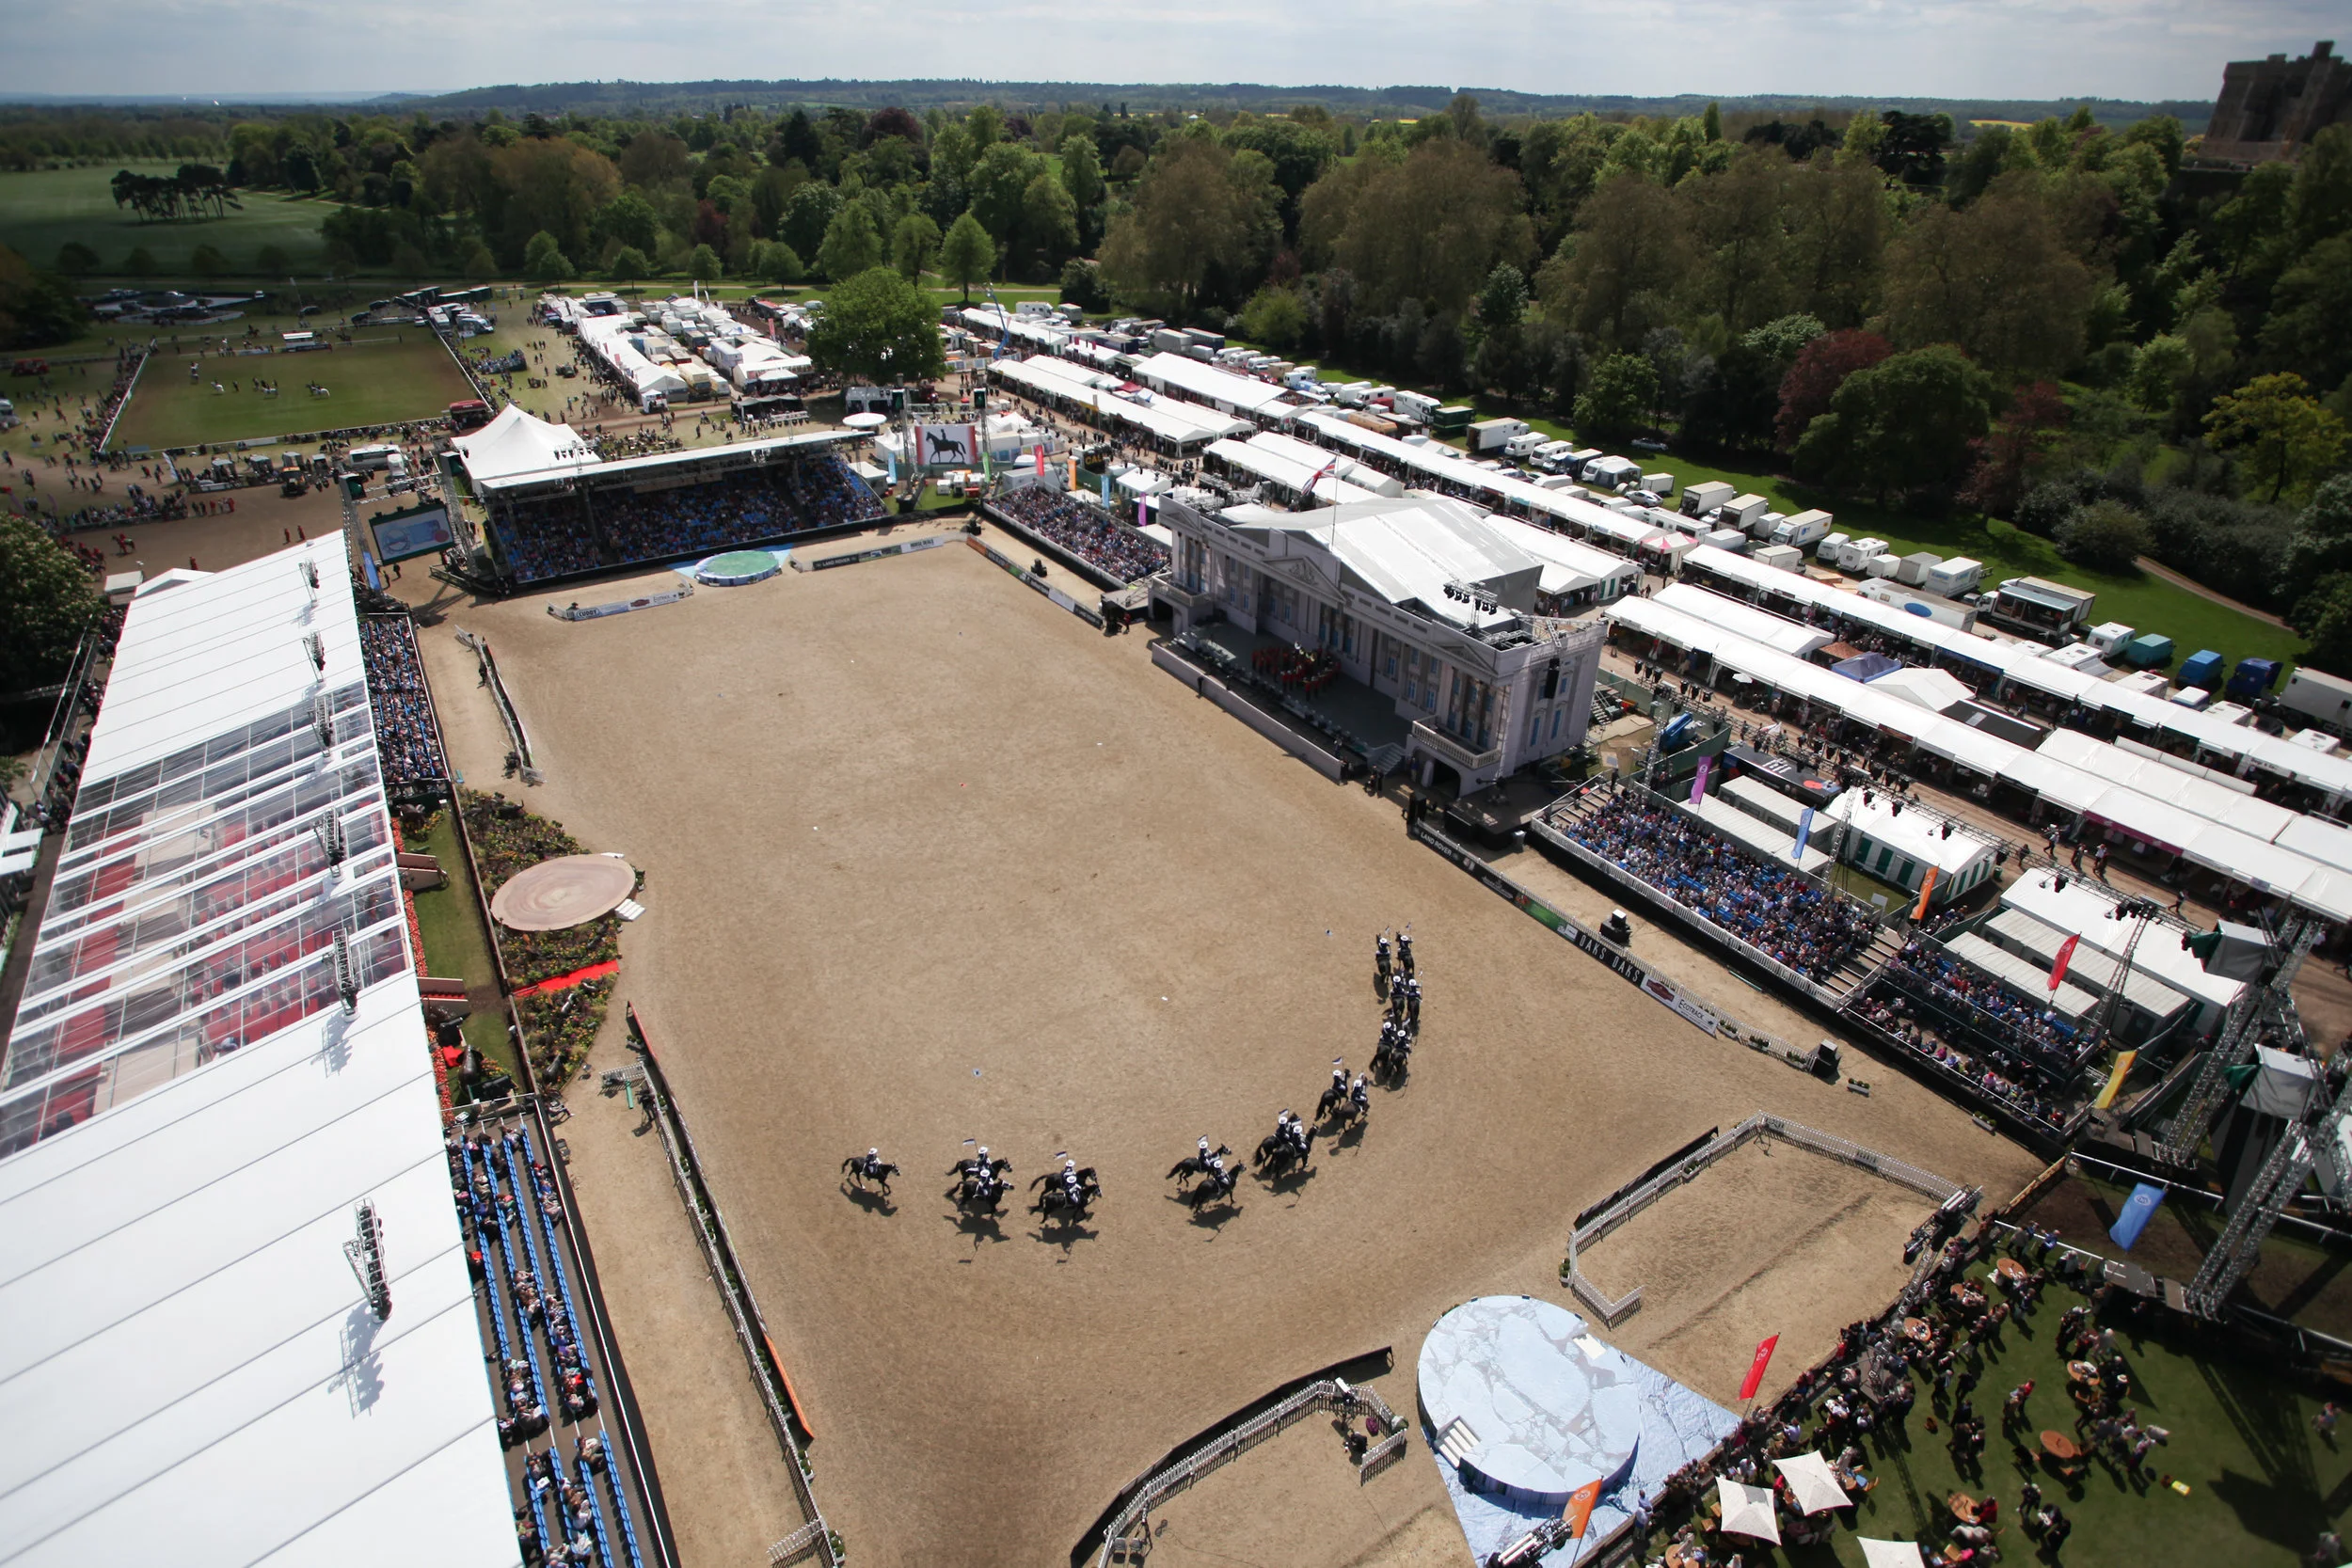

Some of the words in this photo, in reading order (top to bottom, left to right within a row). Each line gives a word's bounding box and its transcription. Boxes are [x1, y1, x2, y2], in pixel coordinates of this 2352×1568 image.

[1421, 832, 1435, 845] LAND
[1435, 840, 1452, 856] ROVER
[1579, 934, 1607, 960] OAKS
[1612, 956, 1640, 983] OAKS
